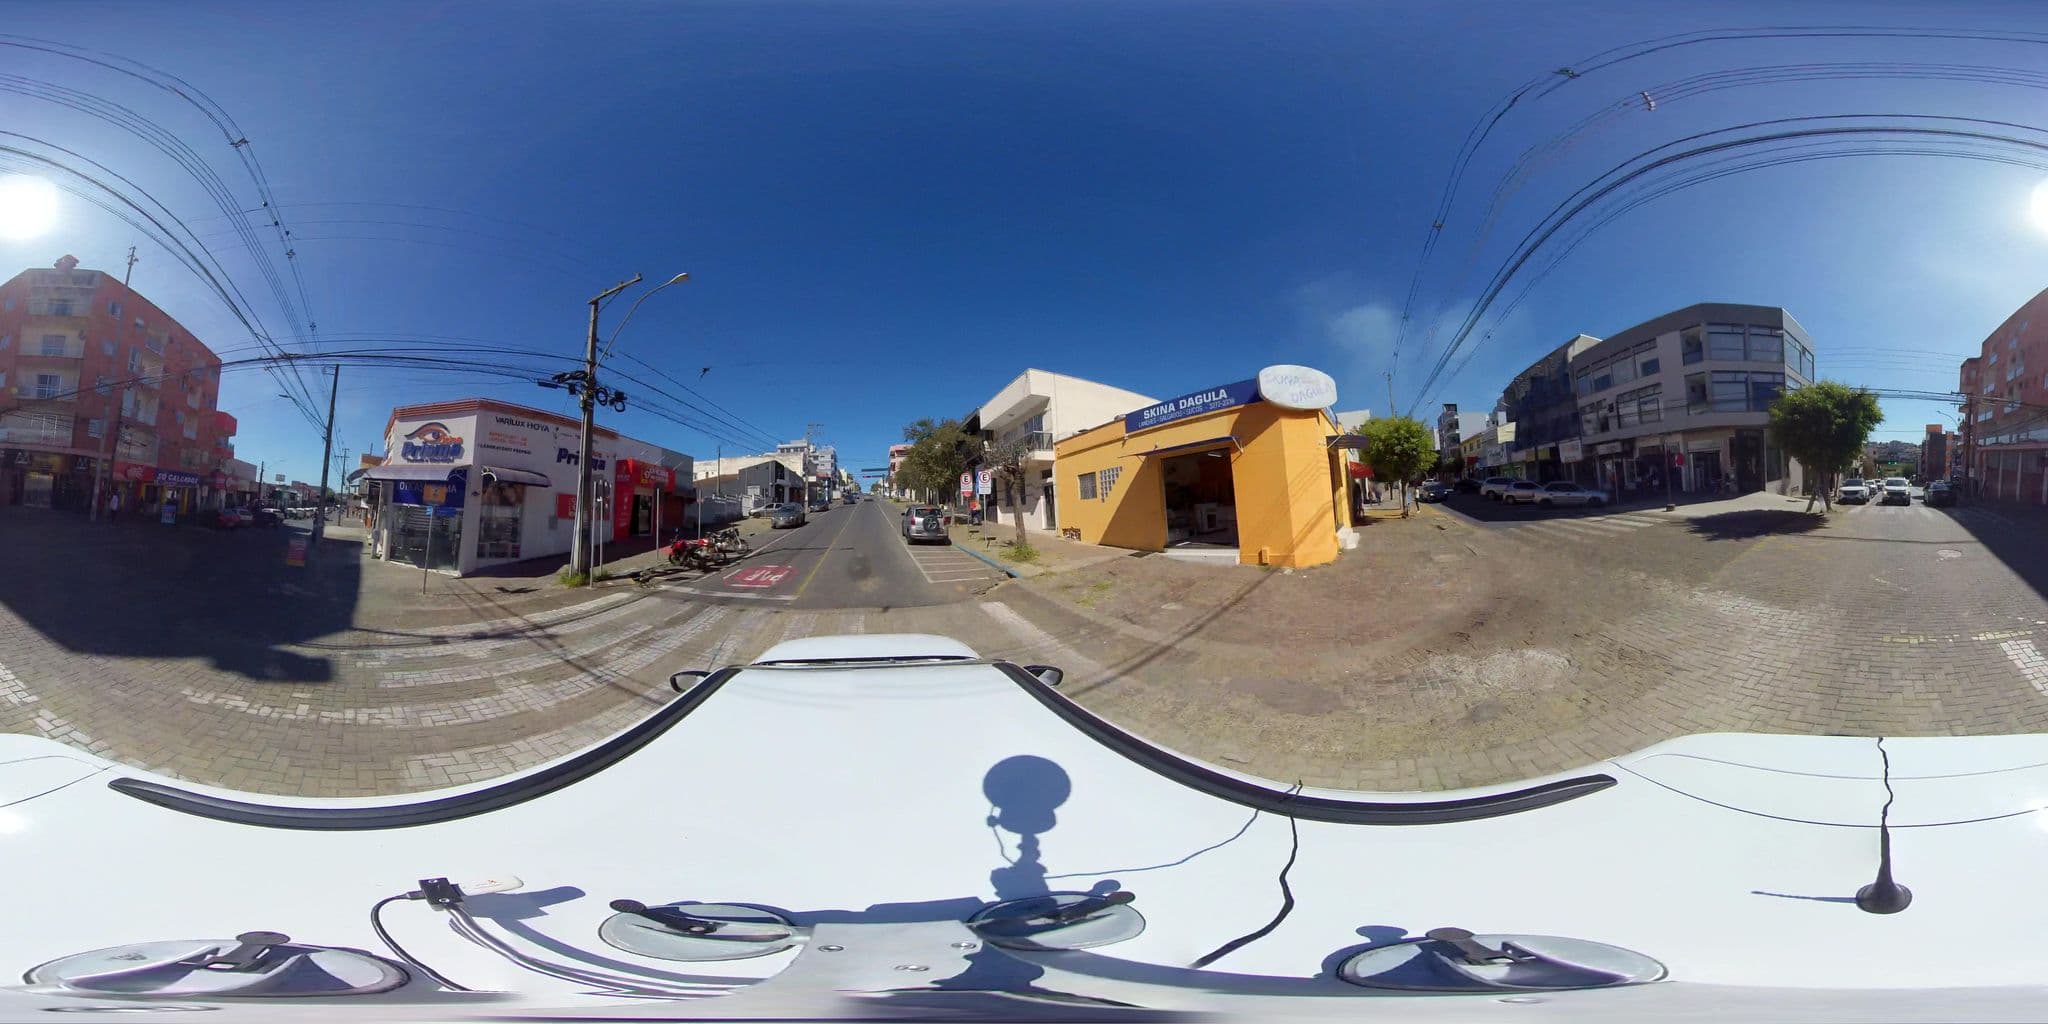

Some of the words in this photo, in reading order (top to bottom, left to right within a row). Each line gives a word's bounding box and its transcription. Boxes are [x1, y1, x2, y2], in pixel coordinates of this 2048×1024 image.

[1143, 403, 1176, 420] SKINA
[1179, 389, 1228, 409] DAGULA
[495, 416, 525, 428] VARILUX
[526, 421, 550, 433] HOYA
